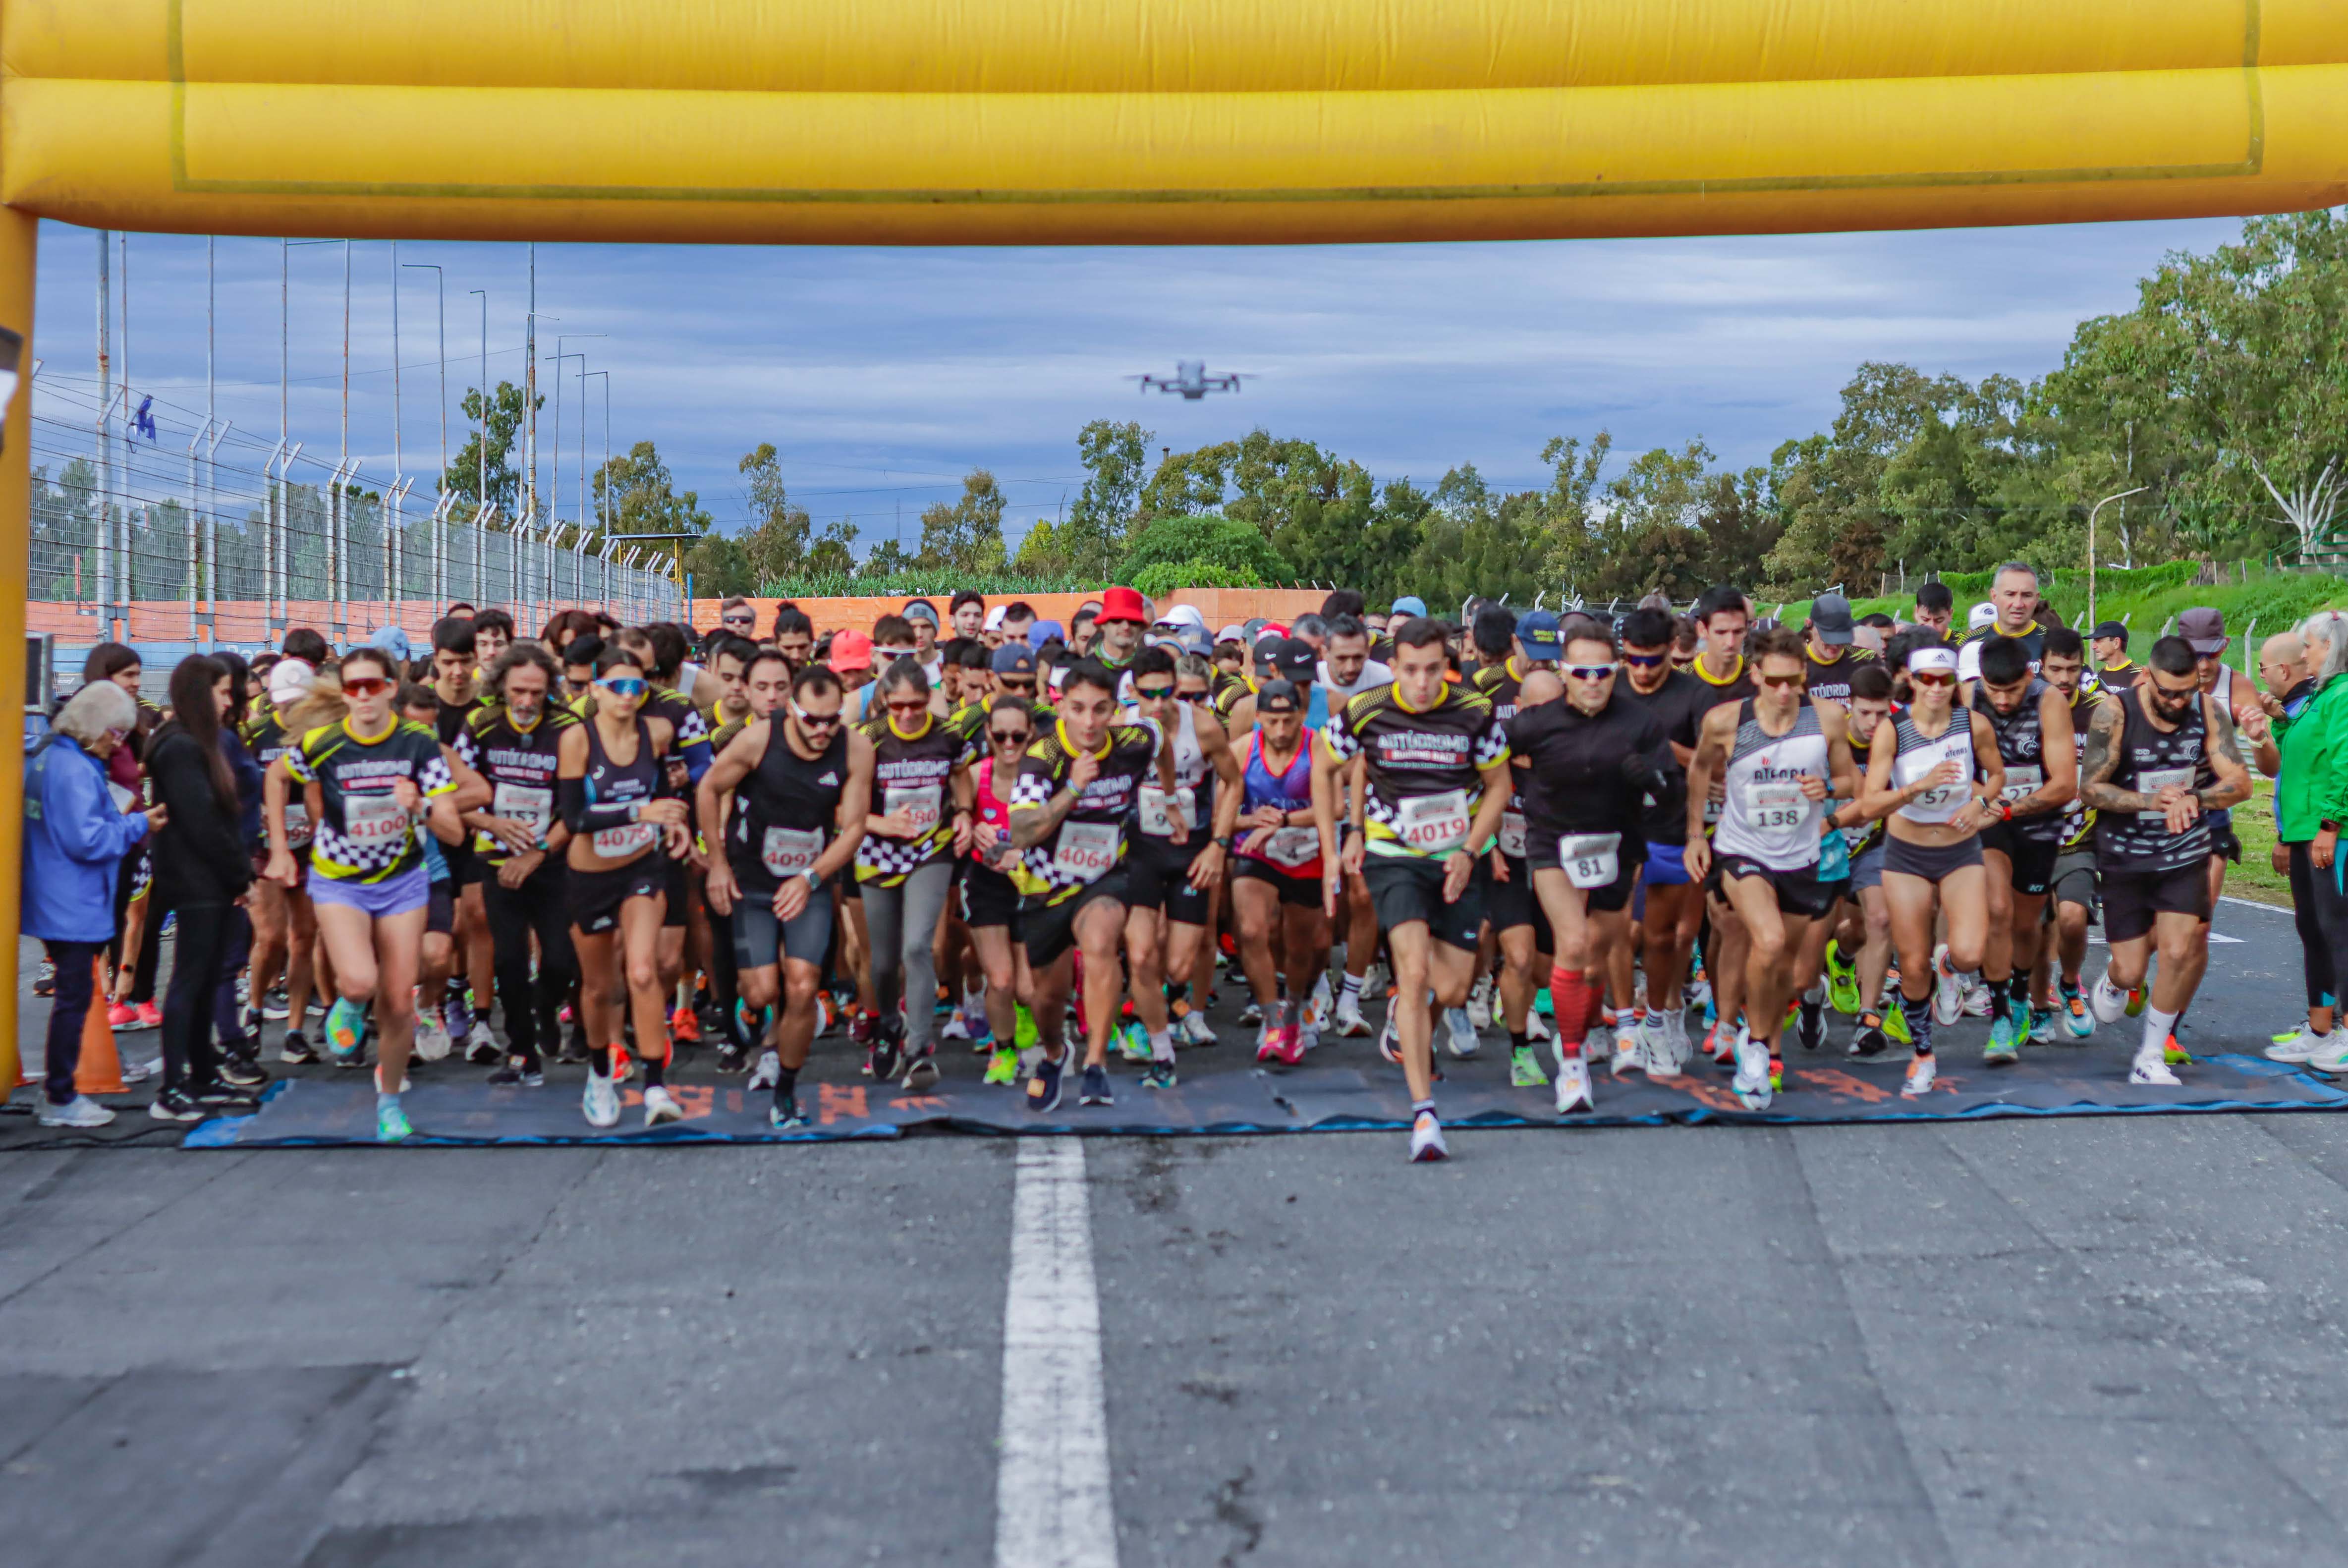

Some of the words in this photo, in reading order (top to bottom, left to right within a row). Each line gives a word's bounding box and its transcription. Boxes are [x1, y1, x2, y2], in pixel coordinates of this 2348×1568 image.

[1925, 789, 1949, 804] 57
[350, 815, 407, 837] 4100
[1758, 810, 1798, 827] 138
[1408, 818, 1465, 843] 4019
[1059, 846, 1112, 869] 4064
[1578, 858, 1605, 878] 81
